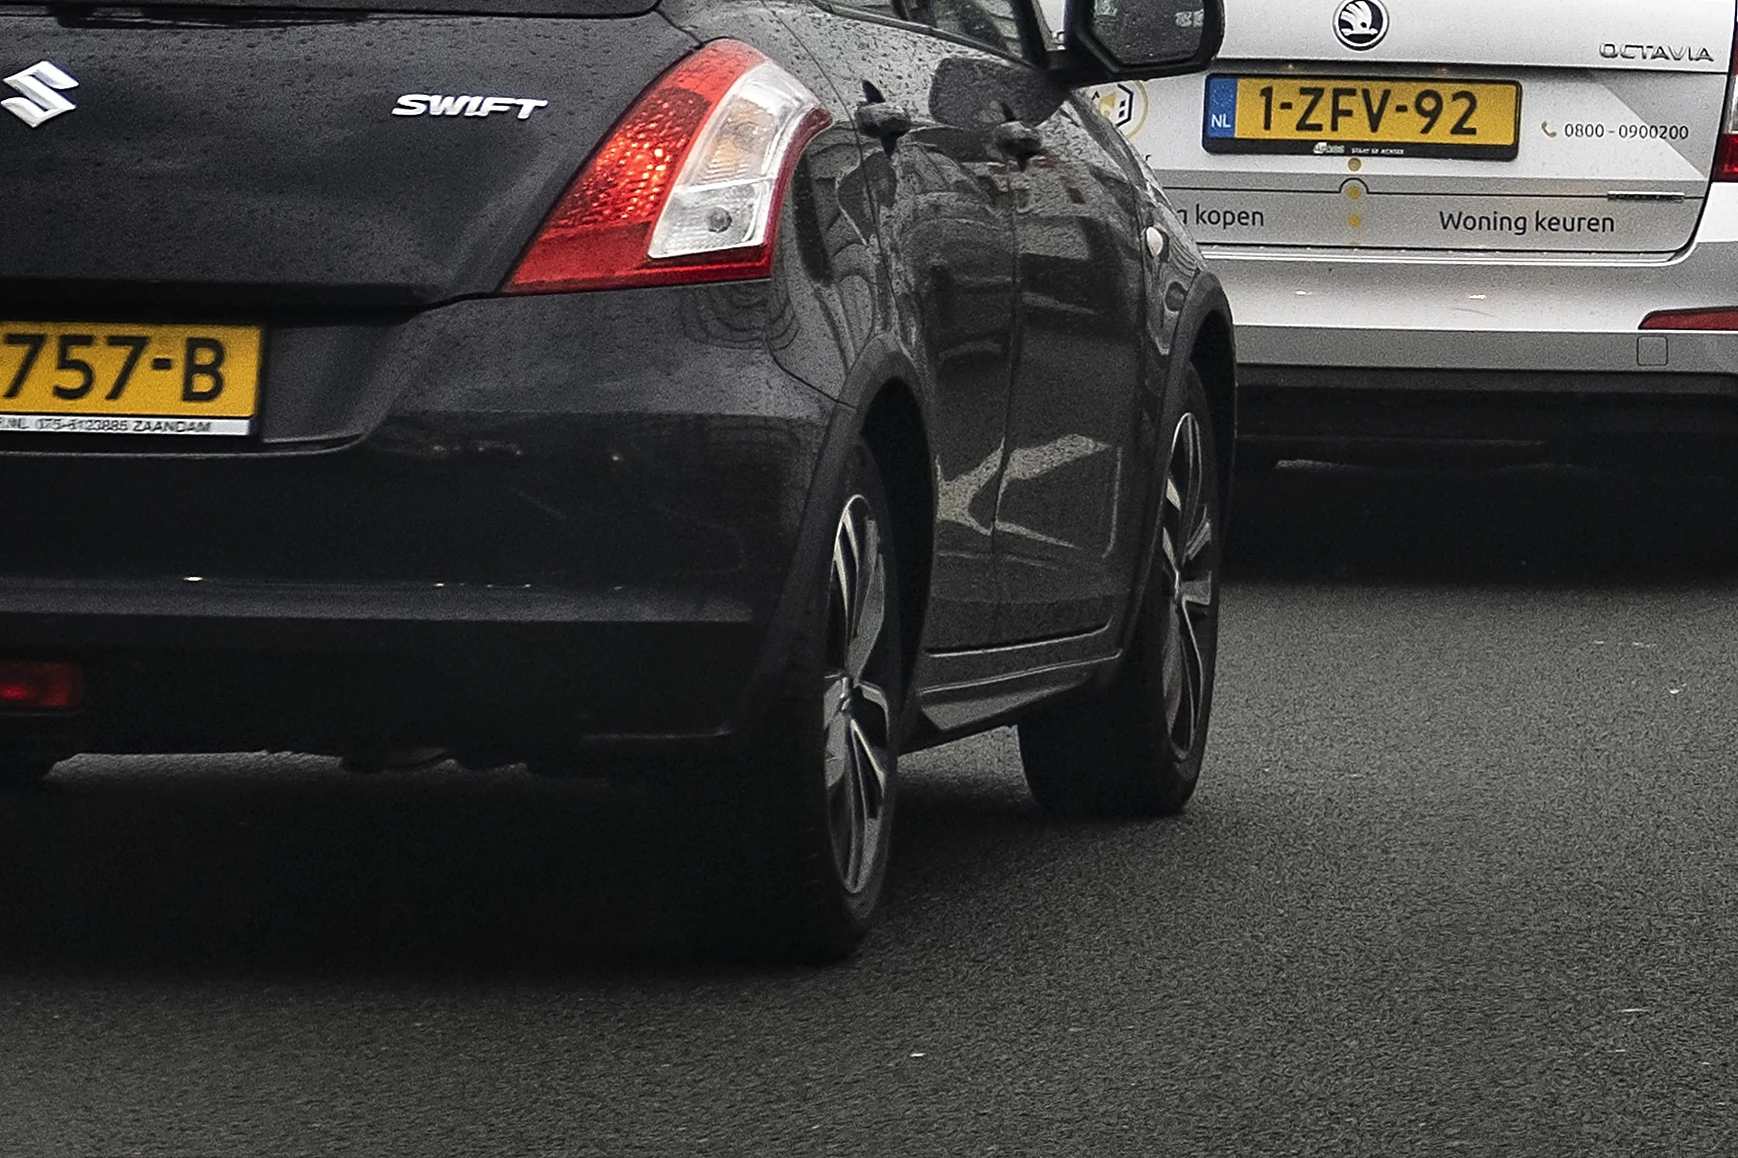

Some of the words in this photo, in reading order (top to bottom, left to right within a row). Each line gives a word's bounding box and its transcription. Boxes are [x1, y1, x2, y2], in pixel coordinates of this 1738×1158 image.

[1599, 43, 1714, 62] OCTAVIA
[391, 93, 549, 120] SWIFT
[1259, 86, 1478, 136] 1-ZFV-92
[1211, 114, 1231, 128] NL
[1564, 123, 1604, 138] 0800
[1618, 124, 1689, 140] 0900200
[1195, 203, 1264, 230] kopen
[1440, 211, 1527, 235] Woning
[1534, 212, 1615, 233] keuren
[3, 333, 225, 403] 757-B
[133, 420, 211, 433] ZAANDAM
